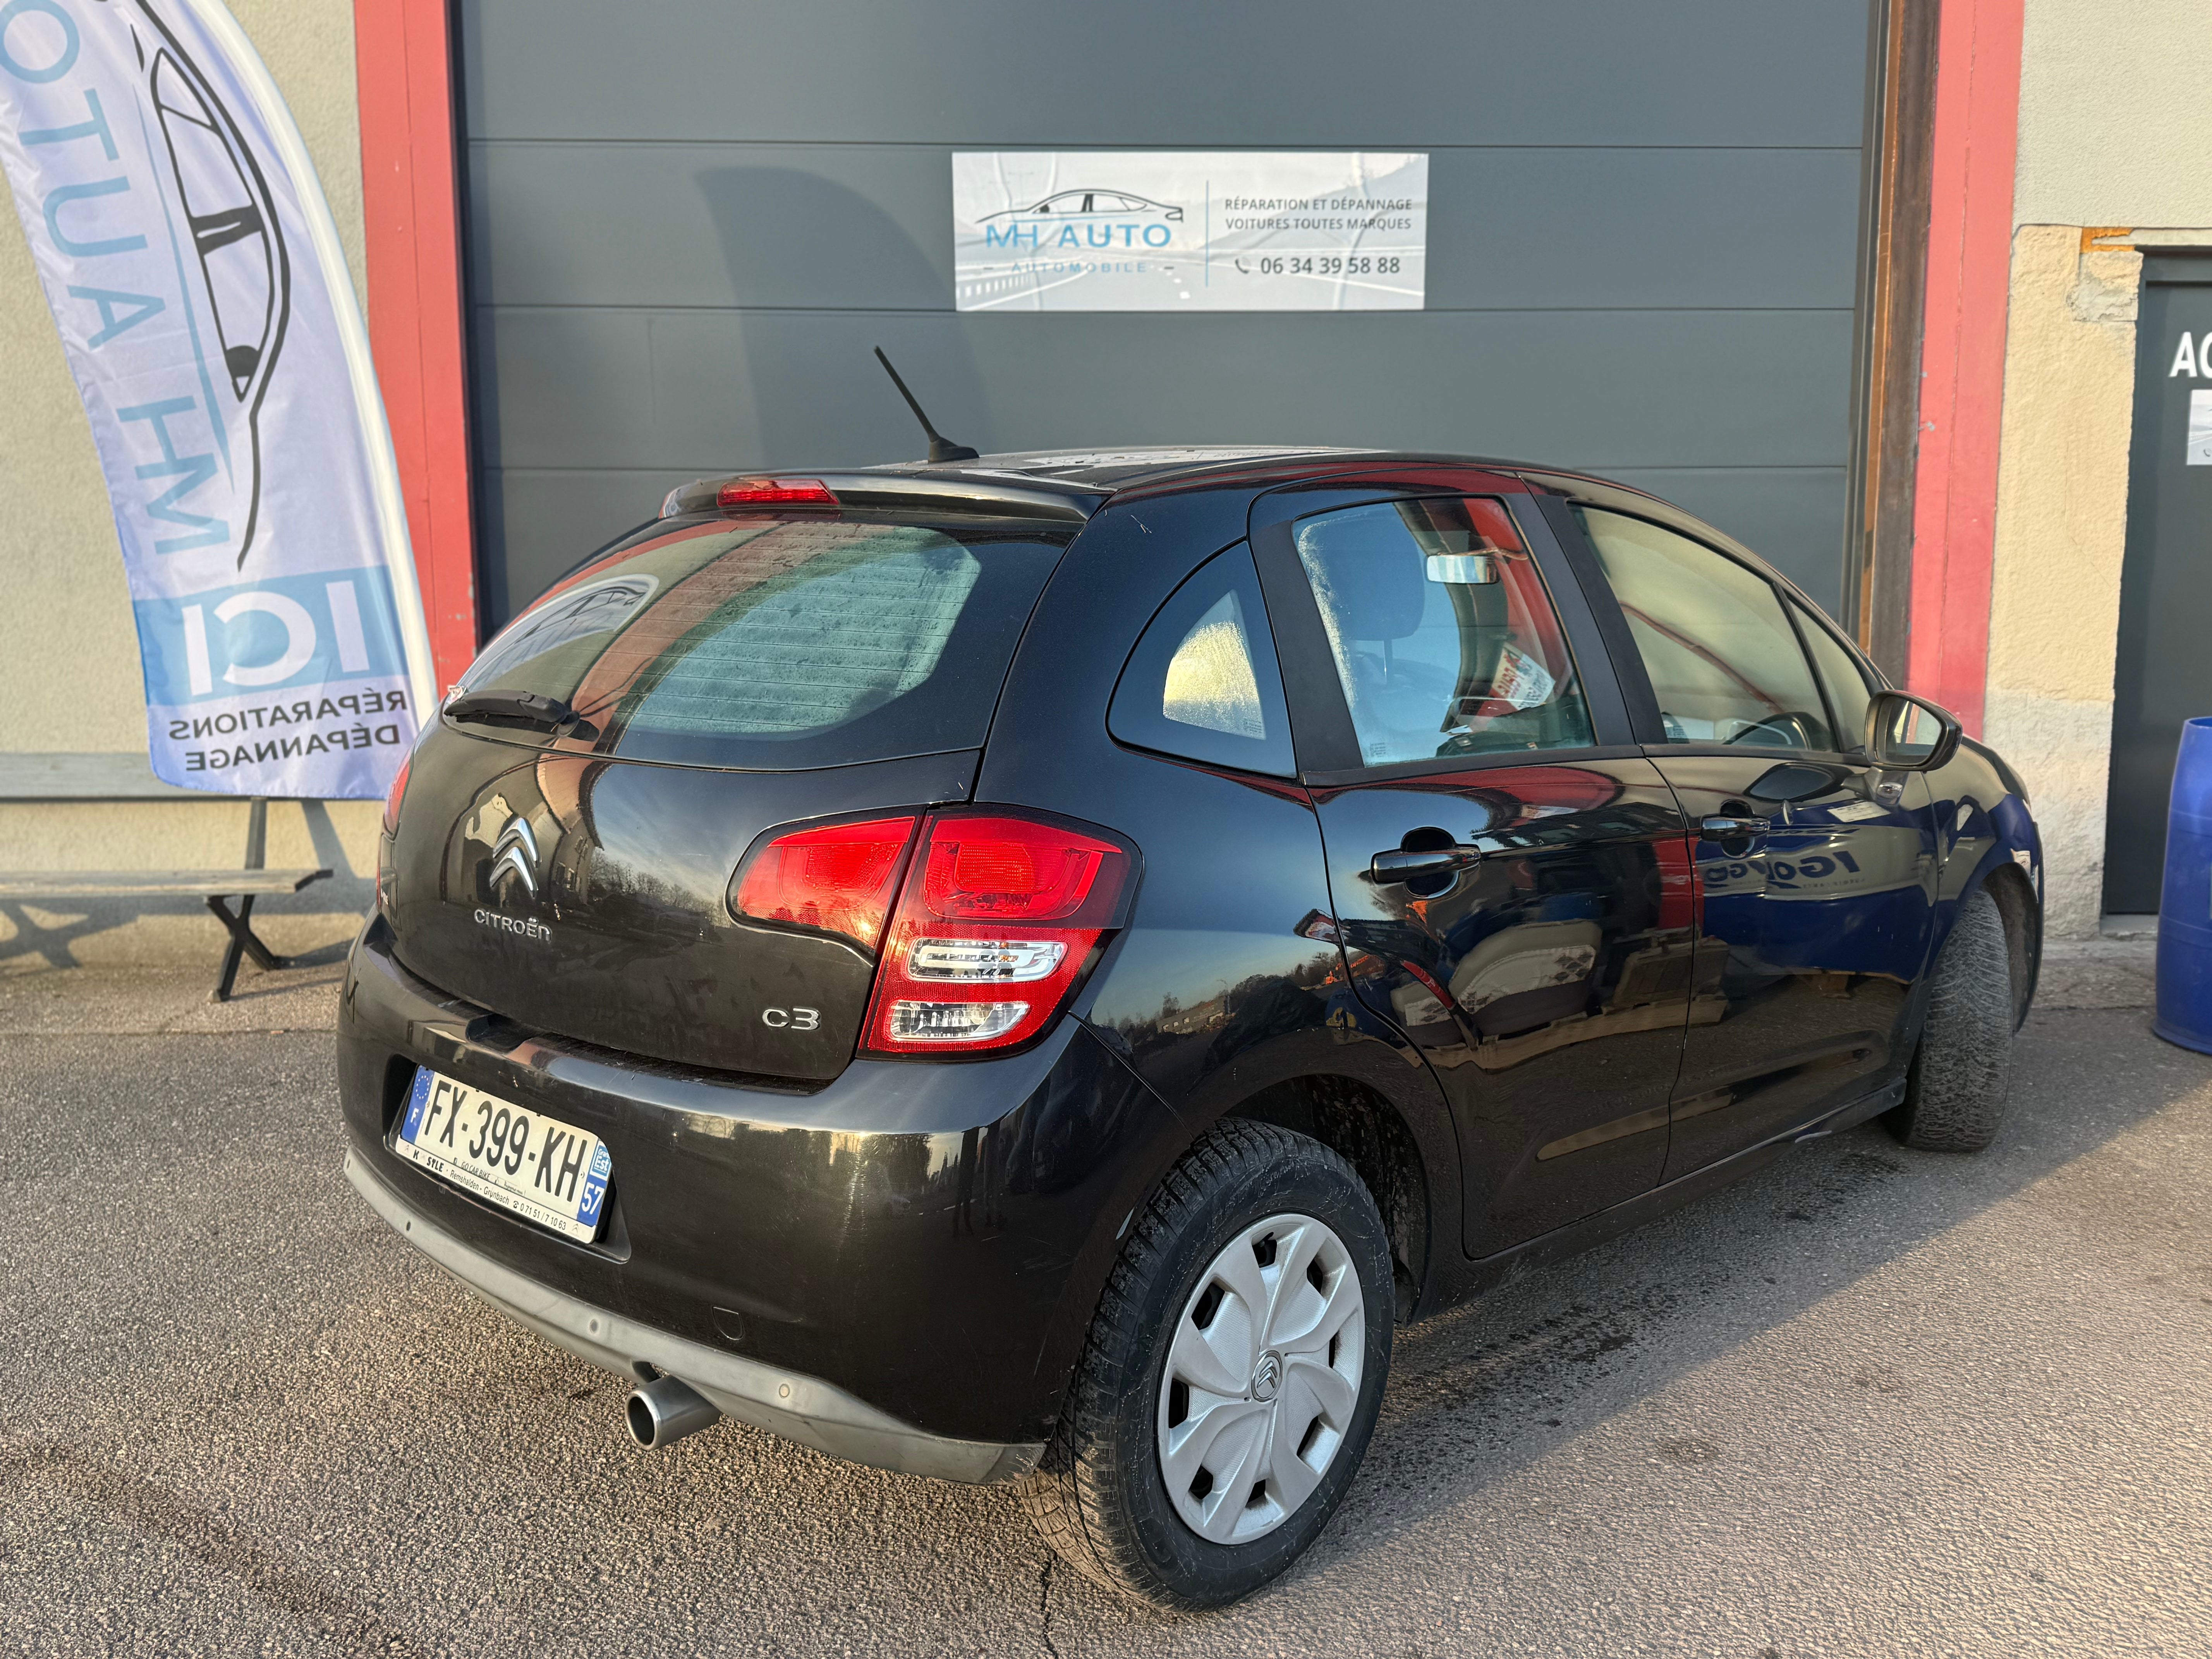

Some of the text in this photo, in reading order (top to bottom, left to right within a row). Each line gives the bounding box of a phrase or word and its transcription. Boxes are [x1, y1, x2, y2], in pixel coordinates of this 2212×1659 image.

[1225, 196, 1412, 210] RÉPARATION ET DÉPANNAGE
[1226, 218, 1412, 230] VOITURES TOUTES MARQUES
[986, 223, 1171, 248] MH AUTO
[1012, 263, 1147, 273] AUTOMOBILE
[1261, 257, 1400, 274] 06 34 39 58 88
[762, 1008, 820, 1030] C3
[410, 1108, 419, 1123] F
[594, 1155, 609, 1171] Est
[582, 1182, 605, 1215] 57
[558, 1220, 567, 1230] 63
